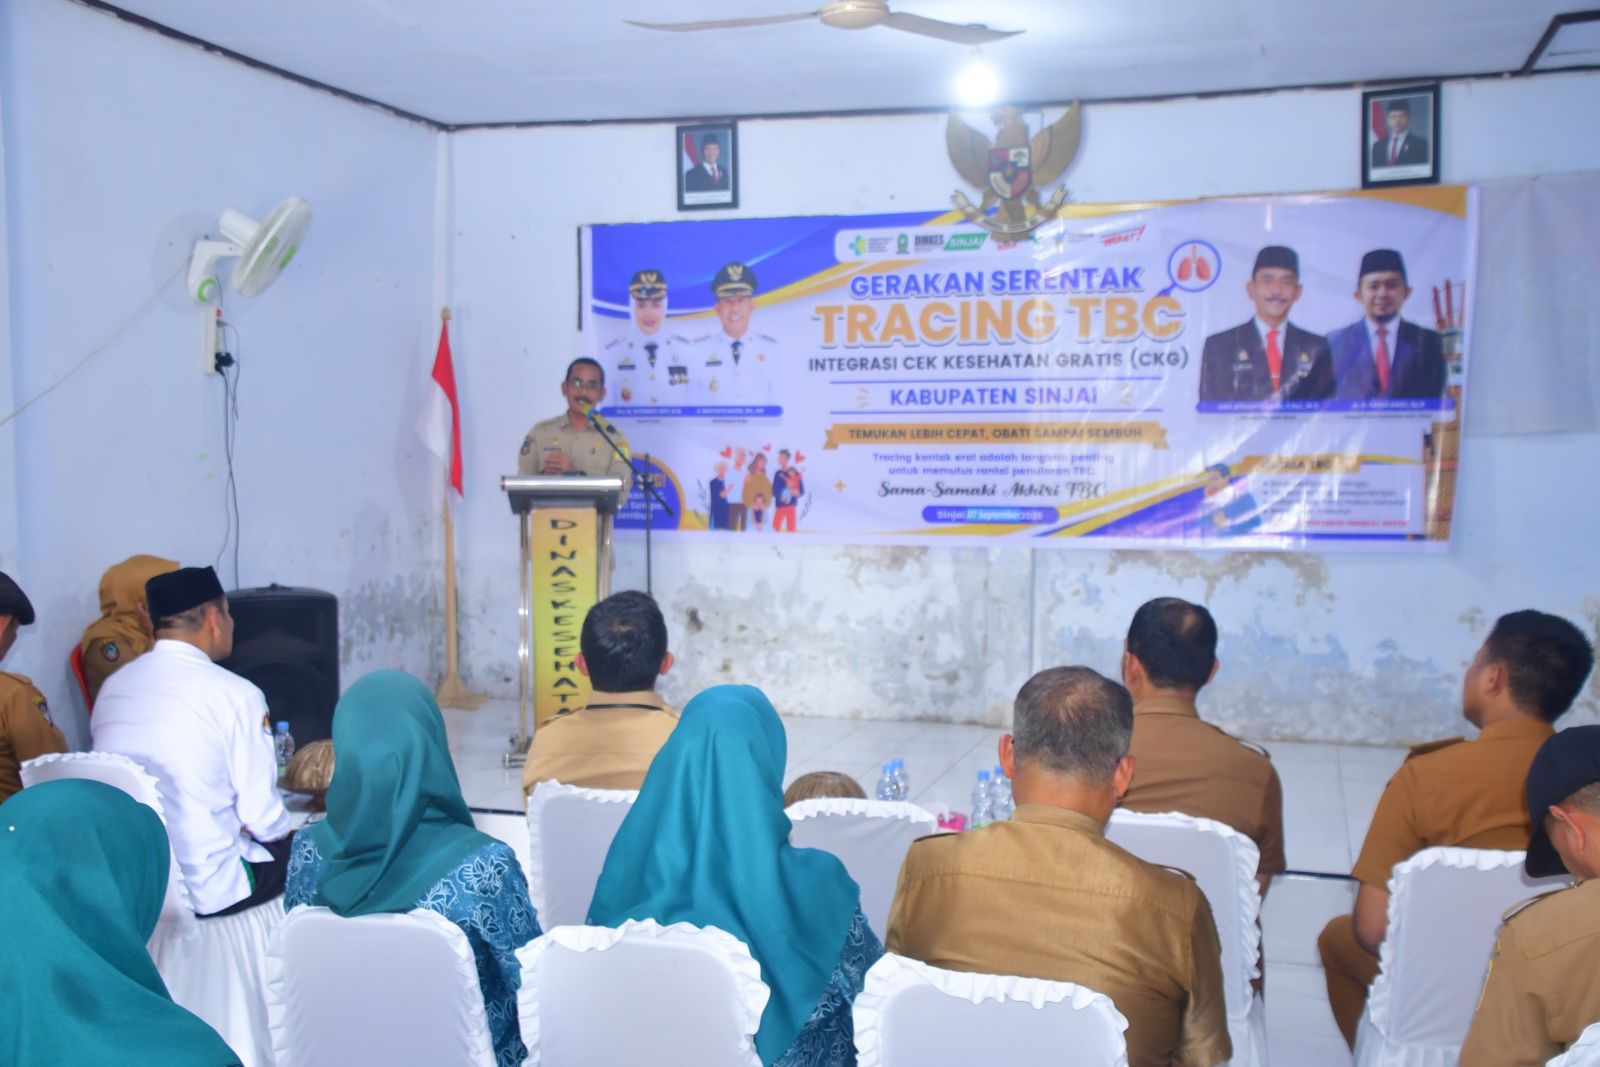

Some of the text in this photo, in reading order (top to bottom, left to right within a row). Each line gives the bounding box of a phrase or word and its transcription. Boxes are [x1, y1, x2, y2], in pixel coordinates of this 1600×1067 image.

[949, 238, 982, 248] SINJAI
[850, 266, 1144, 299] GERAKAN SERENTAK
[812, 296, 1187, 349] TRACING TBC
[808, 347, 1190, 372] INTEGRASI CEK KESEHATAN GRATIS (CKG)
[889, 386, 1098, 407] KABUPATEN SINJAI
[848, 427, 1143, 441] TEMUKAN LEBIH CEPAT, OBATI SAMPAI SEMBUH
[872, 452, 912, 463] Tracing
[915, 452, 951, 462] kontak
[954, 452, 977, 462] erat
[979, 452, 1018, 462] adalah
[888, 466, 919, 476] untuk
[922, 467, 973, 476] memutus
[1002, 480, 1060, 498] Akhiri
[1065, 480, 1108, 500] TBC
[550, 518, 579, 593] DINAS
